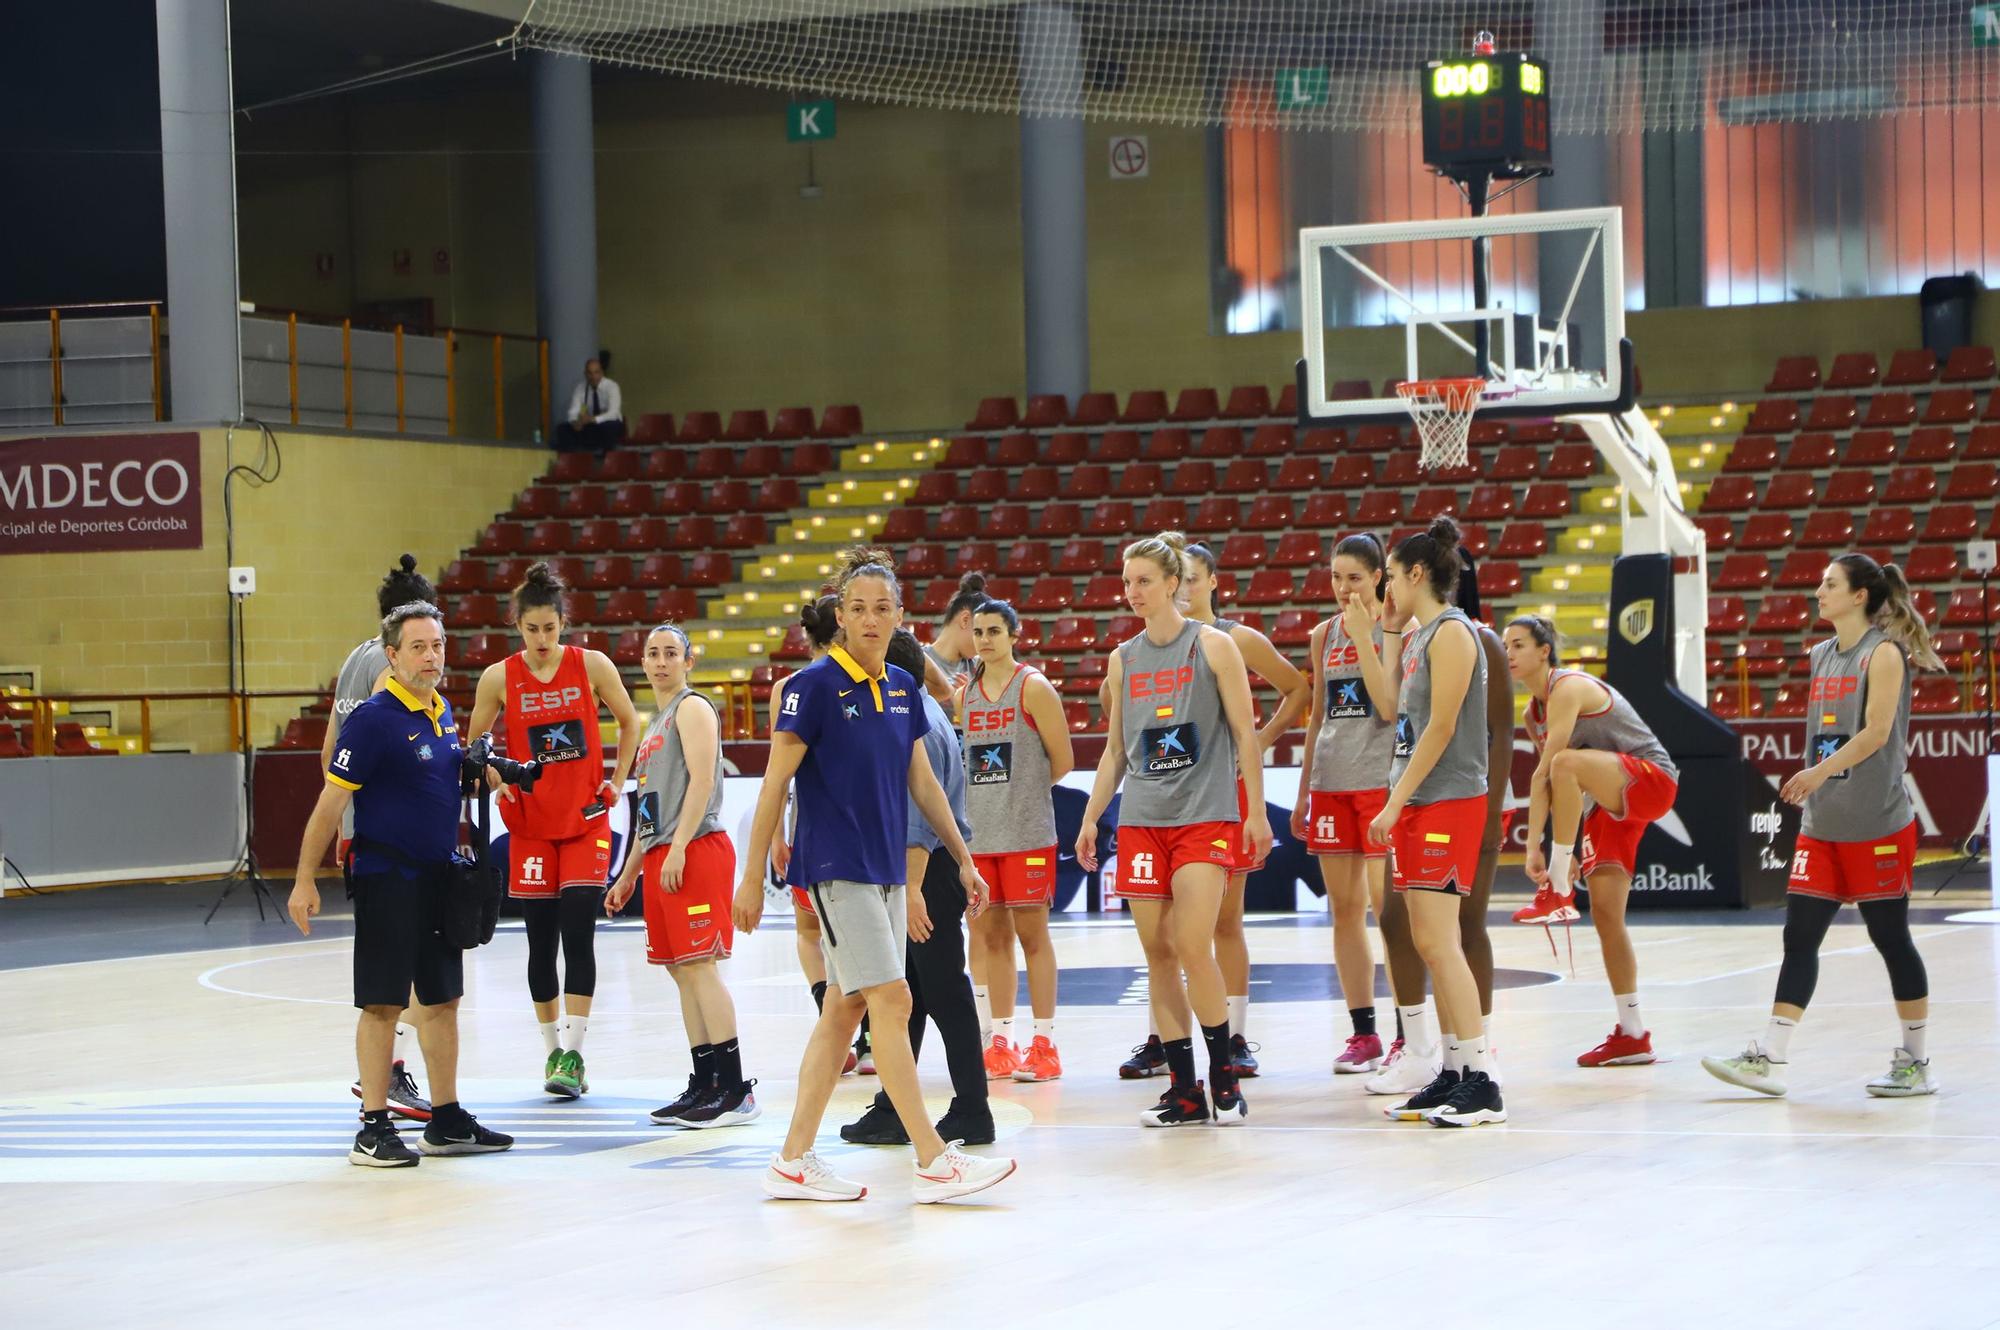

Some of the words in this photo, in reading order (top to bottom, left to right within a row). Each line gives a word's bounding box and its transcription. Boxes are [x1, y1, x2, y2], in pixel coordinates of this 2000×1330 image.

[1293, 74, 1312, 102] L
[800, 107, 820, 136] K
[38, 520, 57, 534] de
[60, 517, 124, 536] Deportes
[127, 515, 188, 532] Córdoba
[1328, 644, 1376, 668] ES
[1129, 665, 1193, 698] ESP
[1810, 676, 1857, 701] ESP
[520, 686, 581, 713] ESP
[968, 707, 1016, 732] ESP
[1330, 708, 1366, 717] CaixaBank
[537, 749, 581, 764] CaixaBank
[1742, 734, 1807, 760] PAL
[1149, 757, 1193, 771] CaixaBank
[973, 771, 1009, 784] CaixaBank
[1315, 815, 1335, 839] fi
[1751, 801, 1783, 844] renfe
[1423, 848, 1448, 857] ESP
[1791, 850, 1810, 875] fi
[522, 856, 545, 880] fi
[1132, 852, 1153, 879] fi
[519, 879, 548, 887] network
[689, 919, 712, 929] ESP
